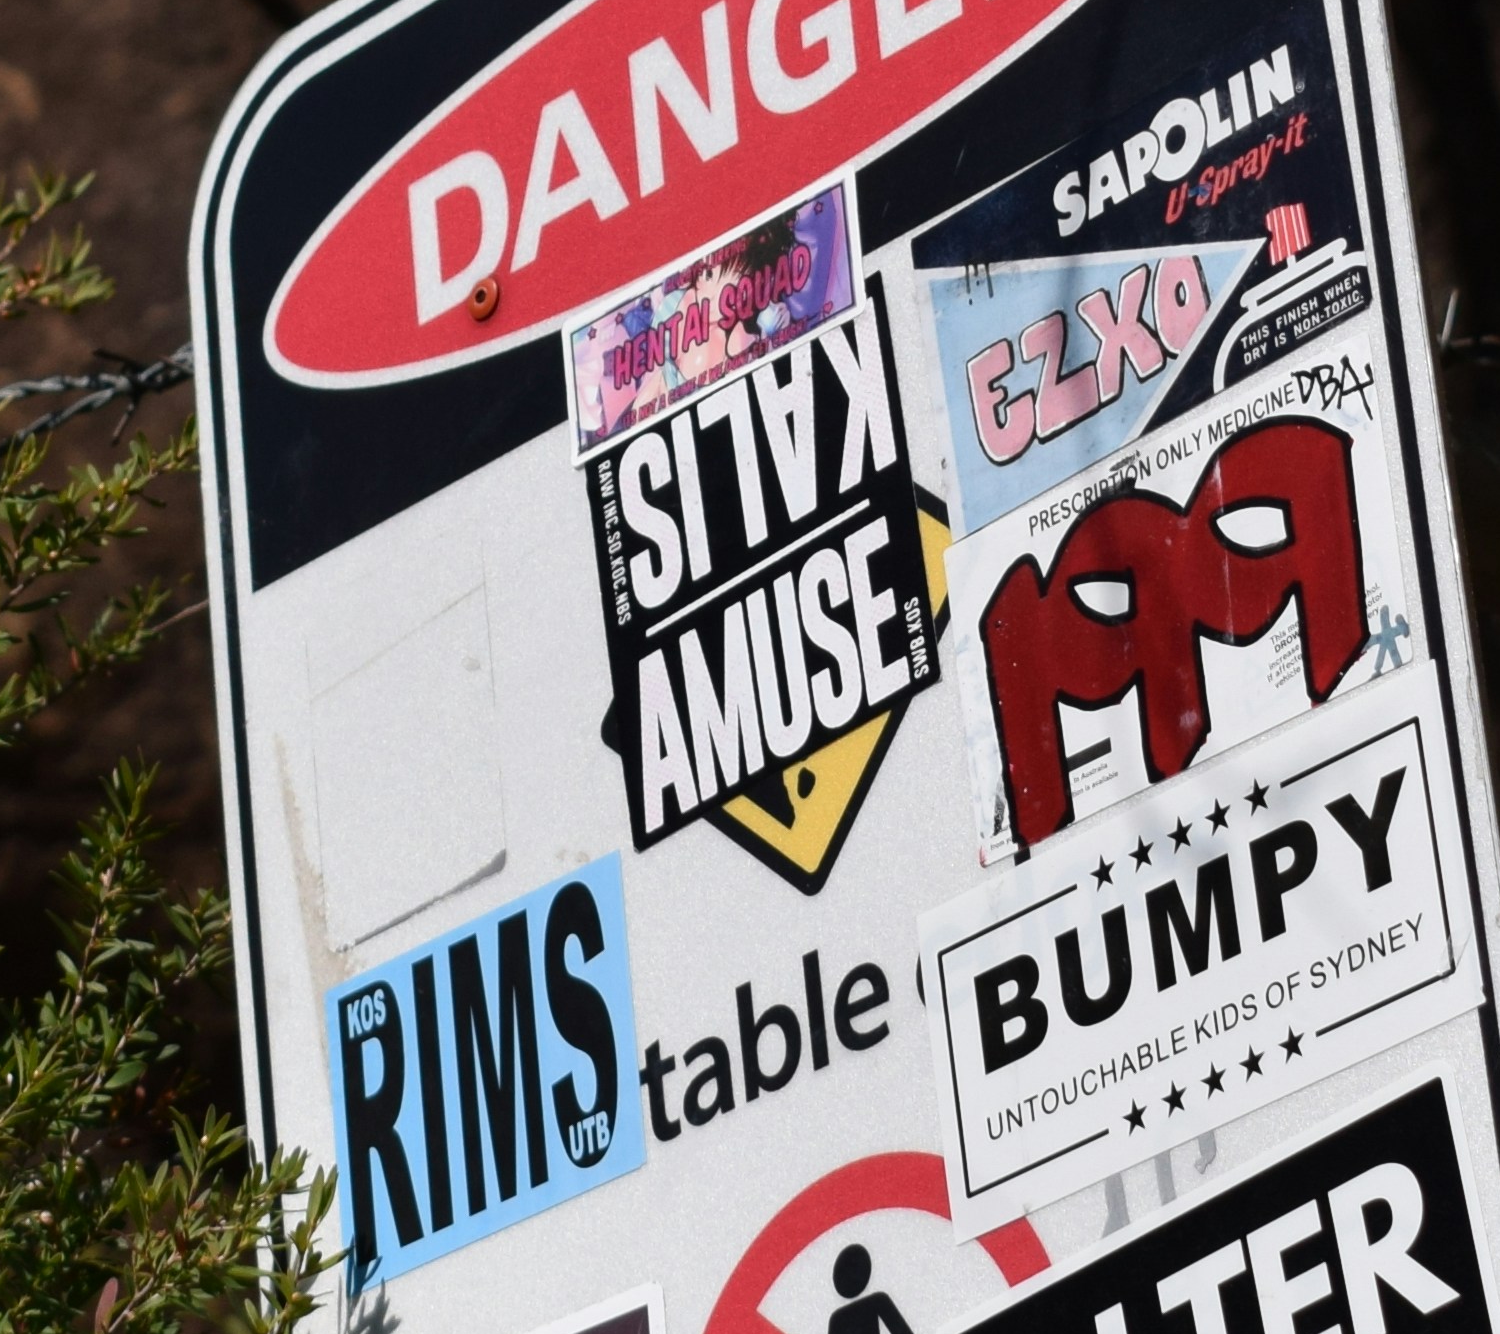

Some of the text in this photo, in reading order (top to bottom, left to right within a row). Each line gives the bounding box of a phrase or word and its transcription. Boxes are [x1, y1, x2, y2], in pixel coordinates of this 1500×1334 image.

[1165, 113, 1307, 224] U-Spray-it
[612, 243, 811, 390] HENTAI SQUAD
[1241, 271, 1361, 350] THIS FINISH WHEN
[1243, 289, 1364, 366] DRY IS NON-TOXIC.
[598, 459, 615, 498] RAW
[619, 297, 897, 608] KALIS
[1028, 380, 1295, 537] PRESCRIPTION ONLY MEDICINE
[639, 515, 911, 834] AMUSE
[903, 596, 930, 680] SWB.KOS
[973, 765, 1408, 1075] BUMPY
[338, 880, 619, 1269] RIMS
[346, 988, 387, 1040] KOS
[986, 912, 1424, 1141] UNTOUCHABLE KIDS OF SYDNEY
[567, 1111, 611, 1164] UTB
